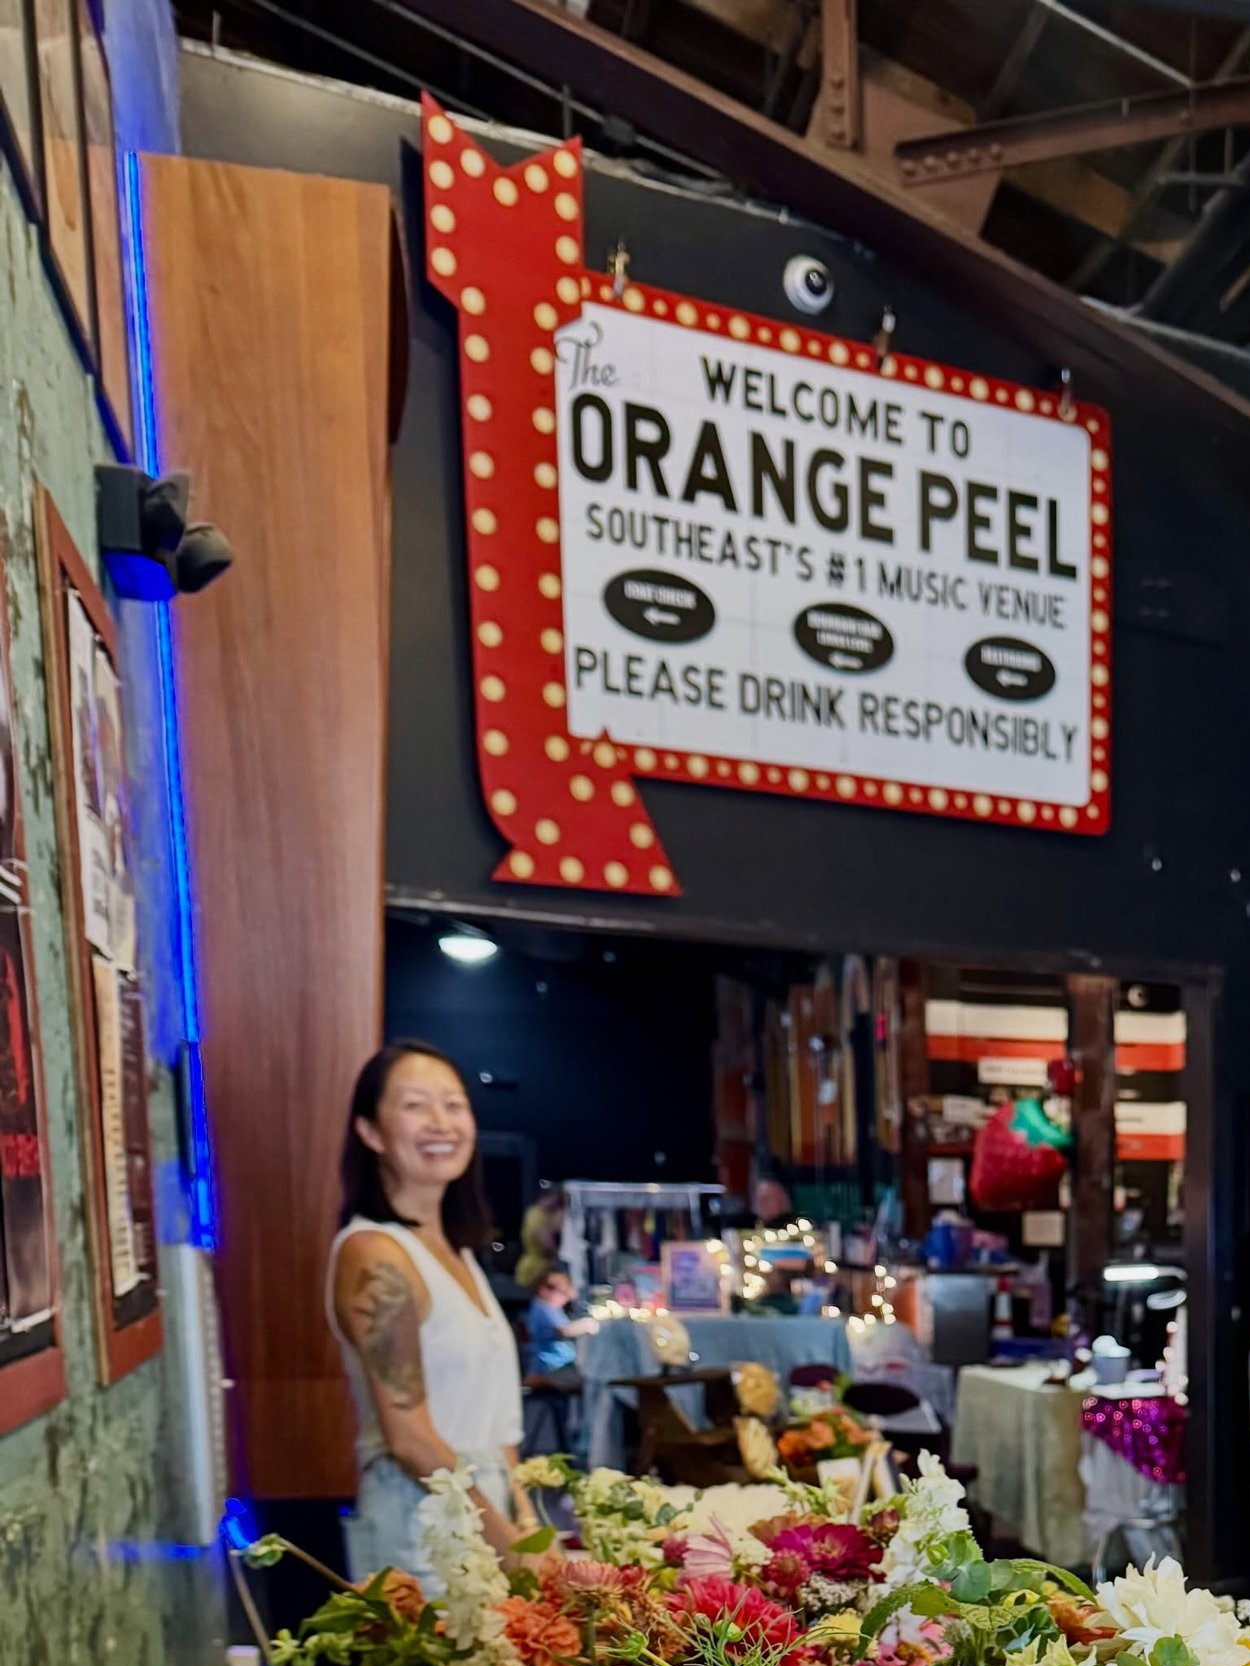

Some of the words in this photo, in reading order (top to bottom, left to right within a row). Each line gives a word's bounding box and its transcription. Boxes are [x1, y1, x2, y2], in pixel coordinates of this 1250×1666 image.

[554, 320, 619, 390] The
[700, 354, 904, 446] WELCOME
[919, 411, 970, 459] TO
[571, 392, 895, 545] ORANGE
[919, 470, 1077, 580] PEEL
[586, 503, 815, 581] SOUTHEAST'S
[826, 552, 867, 595] #1
[878, 561, 967, 611] MUSIC
[977, 581, 1067, 630] VENUE
[574, 646, 727, 710] PLEASE
[739, 673, 845, 730] DRINK
[859, 691, 1078, 764] RESPONSIBLY
